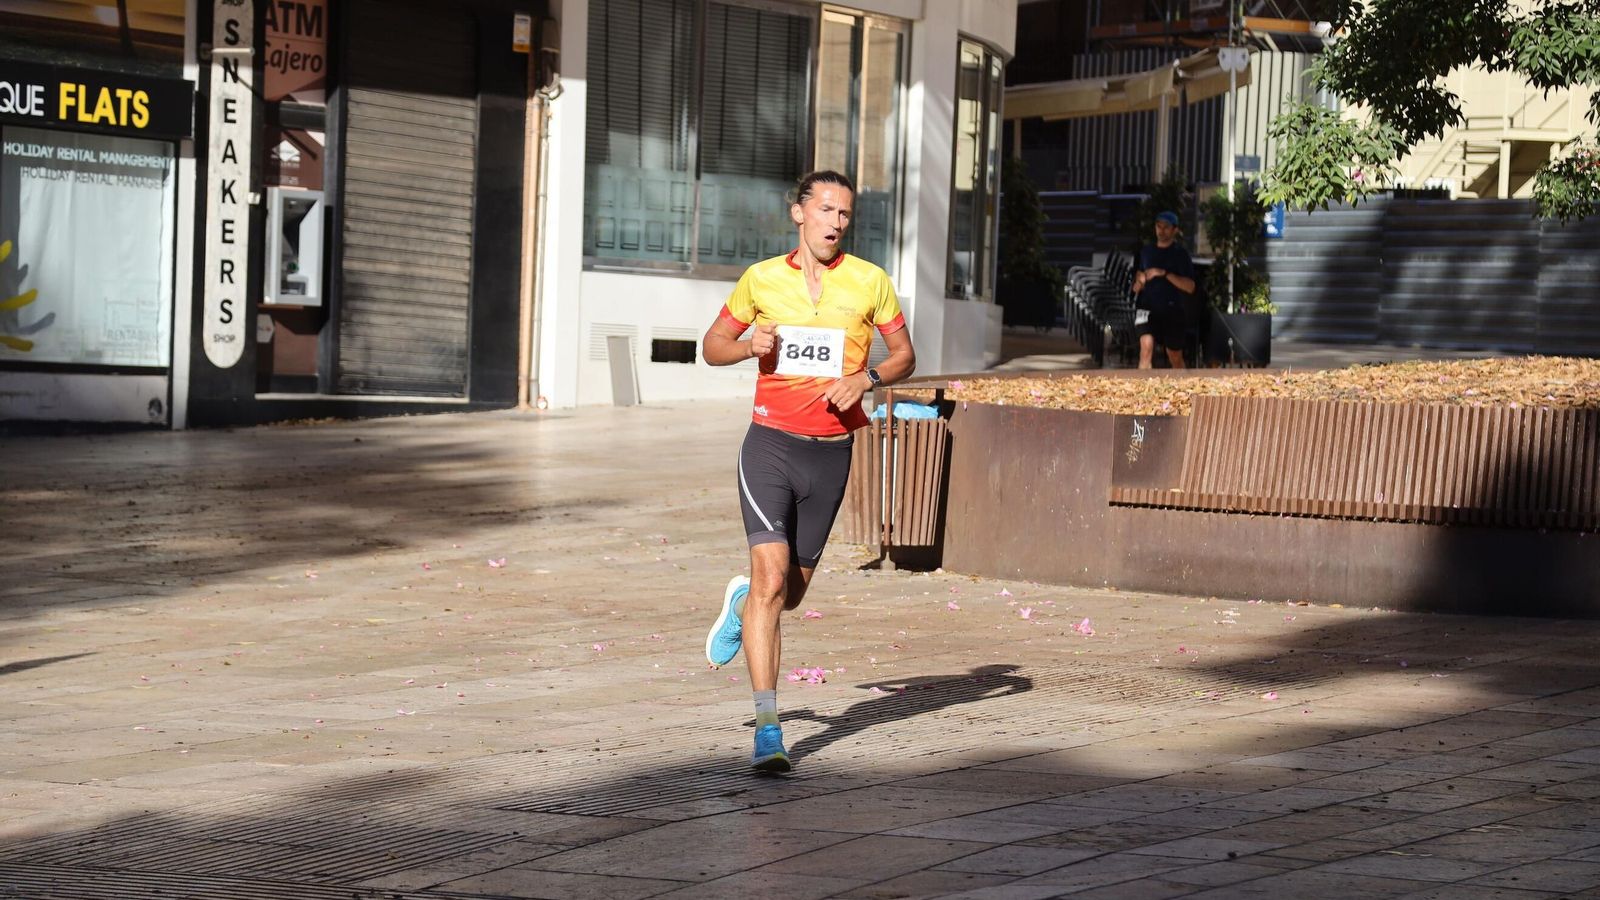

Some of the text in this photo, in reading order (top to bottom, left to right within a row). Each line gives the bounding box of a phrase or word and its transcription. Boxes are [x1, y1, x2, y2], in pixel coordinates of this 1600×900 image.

[265, 0, 323, 39] ATM
[0, 81, 150, 129] QUE FLATS
[3, 142, 171, 169] HOLIDAY RENTAL MANAGEMENT
[219, 18, 240, 325] SNEAKERS
[786, 343, 831, 362] 848
